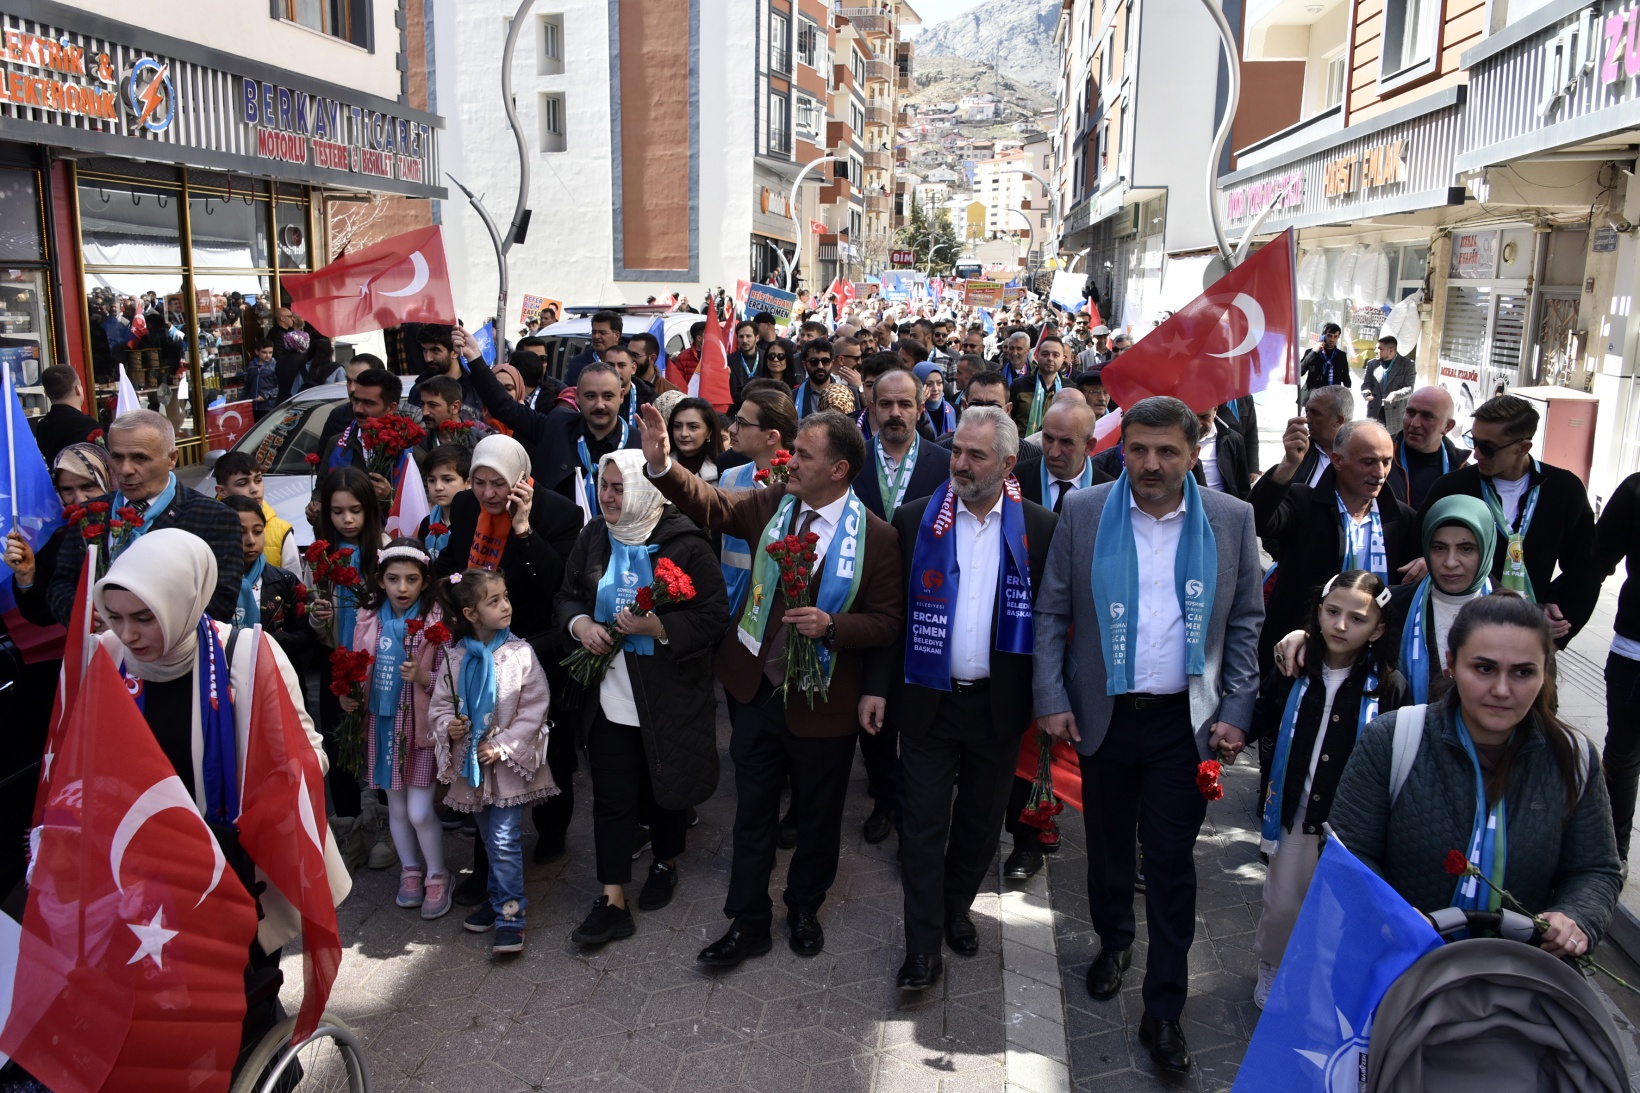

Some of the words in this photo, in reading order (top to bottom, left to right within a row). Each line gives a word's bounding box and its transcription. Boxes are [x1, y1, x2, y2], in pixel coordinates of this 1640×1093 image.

[0, 27, 86, 77] EKTRİK
[98, 53, 116, 85] &
[243, 78, 341, 142] BERKAY
[351, 106, 428, 159] TİCARET
[257, 126, 307, 165] MOTORLU
[312, 138, 349, 171] TESTERE
[351, 145, 359, 173] &
[361, 147, 394, 179] BİSİKLET
[1361, 139, 1408, 190] EMLAK
[893, 253, 913, 262] BİM
[525, 296, 543, 305] SEFER
[748, 300, 770, 313] ERCAN
[774, 297, 792, 309] ADAYI
[1440, 366, 1458, 379] MERAL
[913, 611, 948, 625] ERCAN
[912, 623, 947, 639] ÇİMEN
[913, 636, 944, 648] BELEDİYE
[914, 644, 942, 656] BAŞKANI
